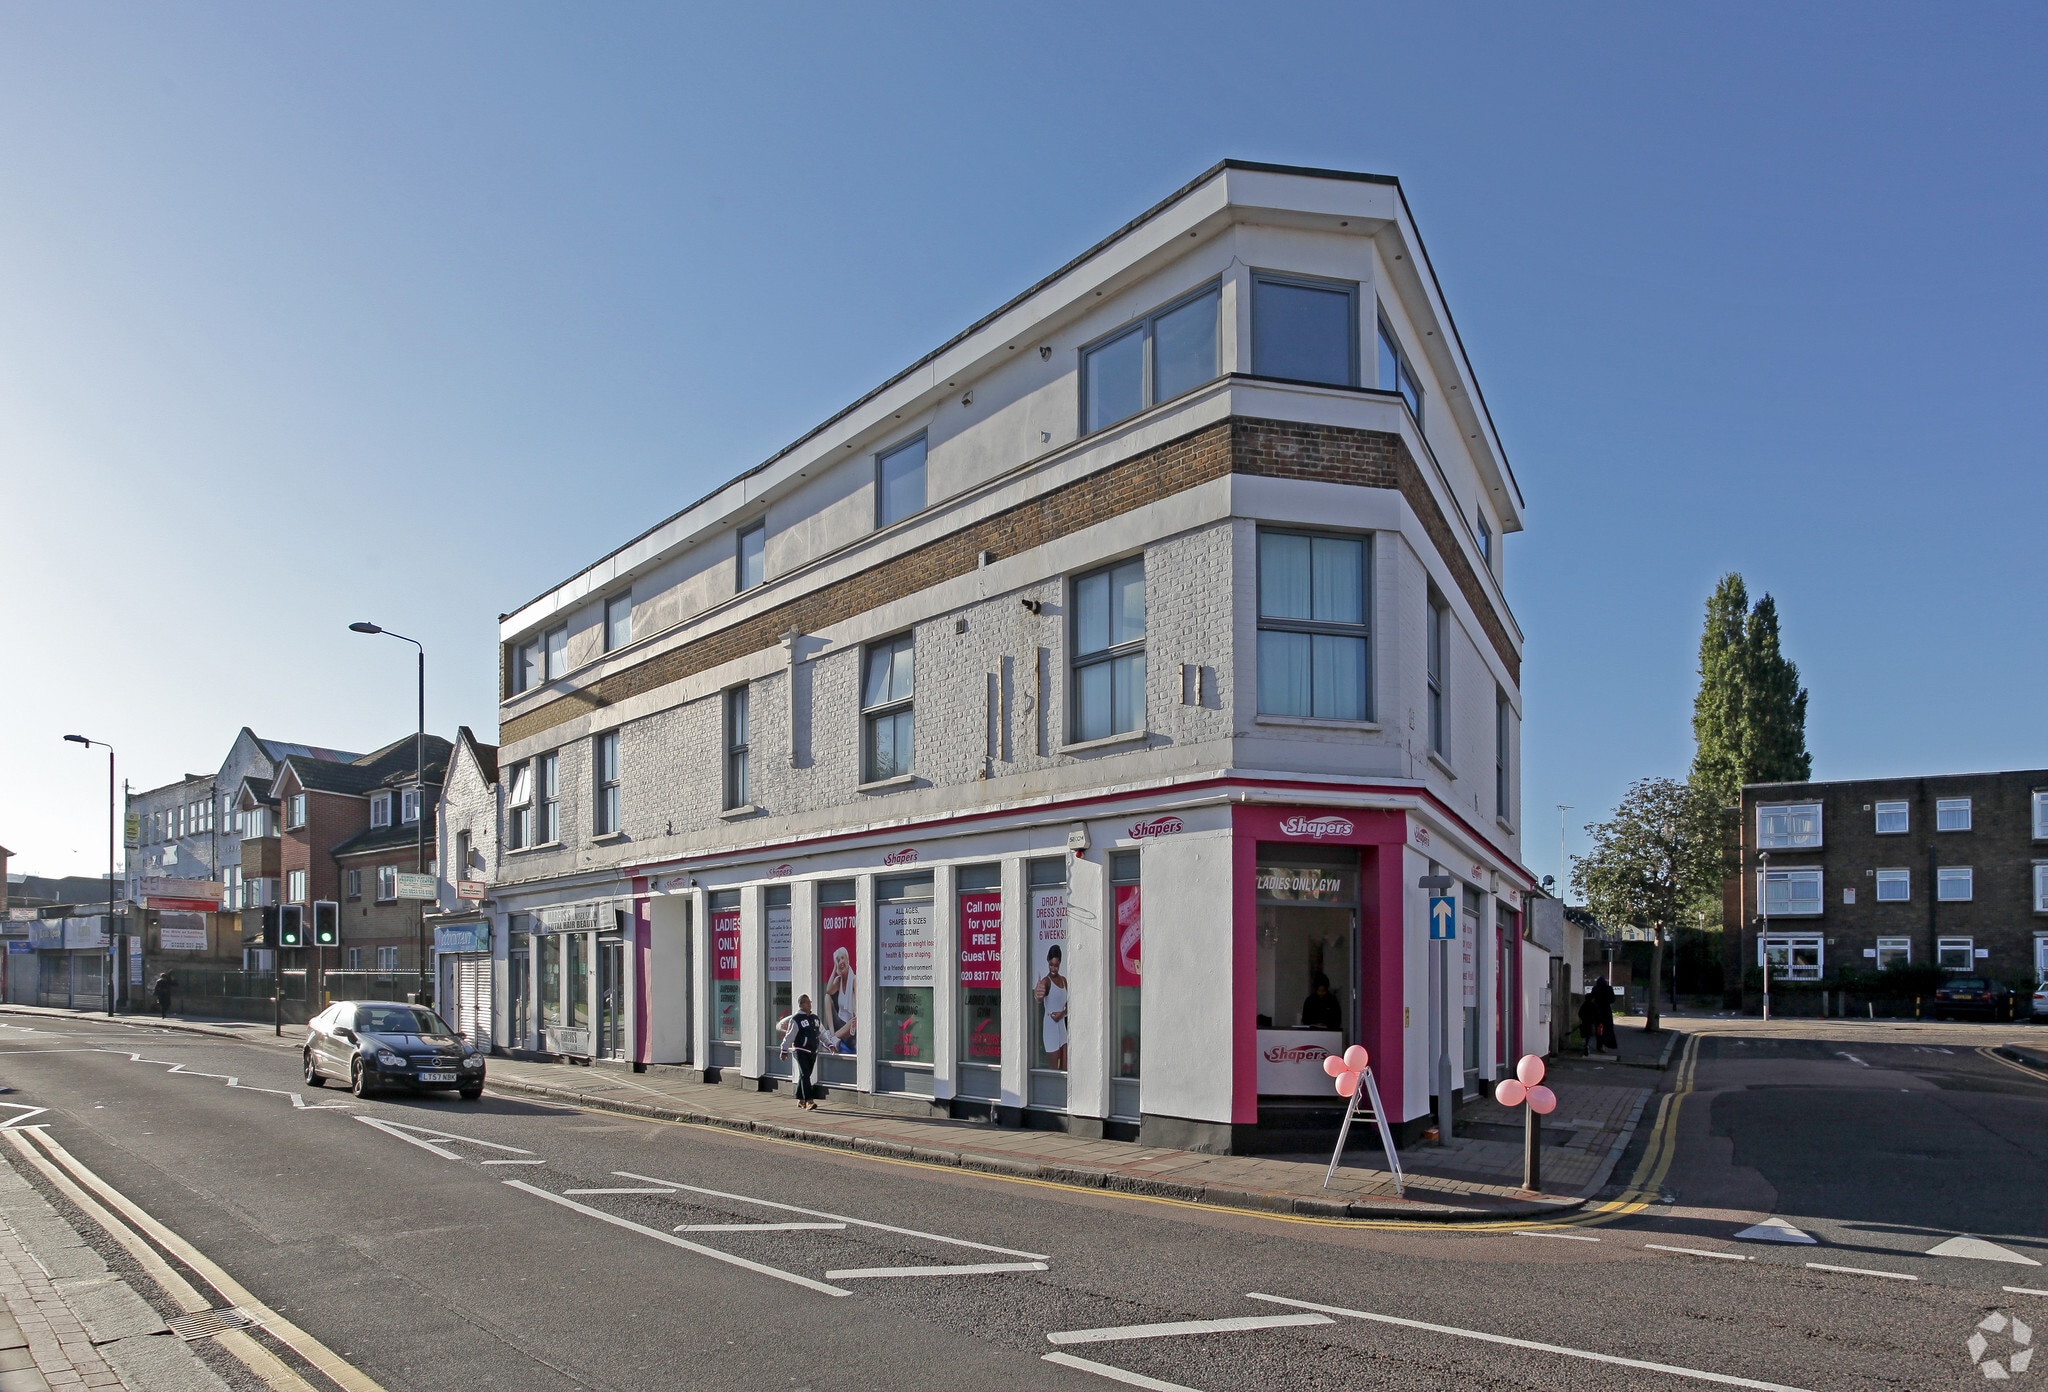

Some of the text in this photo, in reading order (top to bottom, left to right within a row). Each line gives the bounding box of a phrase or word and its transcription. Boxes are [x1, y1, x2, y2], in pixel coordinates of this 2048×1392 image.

[1133, 820, 1183, 838] Shapers
[1286, 816, 1353, 838] Shapers
[886, 852, 919, 866] Shapers
[768, 867, 793, 878] Shapers
[1257, 877, 1341, 892] LADIES ONLY GYM
[966, 901, 1001, 913] Call now
[1041, 896, 1063, 907] DROP A
[895, 907, 904, 915] ALL
[1036, 907, 1055, 918] DRESS
[563, 920, 575, 929] HAIR
[576, 919, 598, 928] BEAUTY
[715, 917, 741, 932] LADIES
[823, 917, 833, 929] 020
[834, 916, 848, 929] 8317
[888, 918, 907, 926] SHAPES
[912, 917, 927, 925] SIZES
[968, 918, 1001, 931] for your
[1041, 918, 1063, 929] IN JUST
[895, 928, 920, 936] WELCOME
[1039, 929, 1067, 940] 6 WEEKS!
[718, 937, 739, 951] ONLY
[913, 940, 927, 948] weight
[972, 933, 997, 945] FREE
[961, 950, 1001, 962] Guest Vis
[720, 956, 738, 970] GYM
[961, 971, 973, 981] 020
[973, 971, 989, 981] 8317
[1270, 1046, 1328, 1064] Shapers
[423, 1073, 442, 1081] LT57
